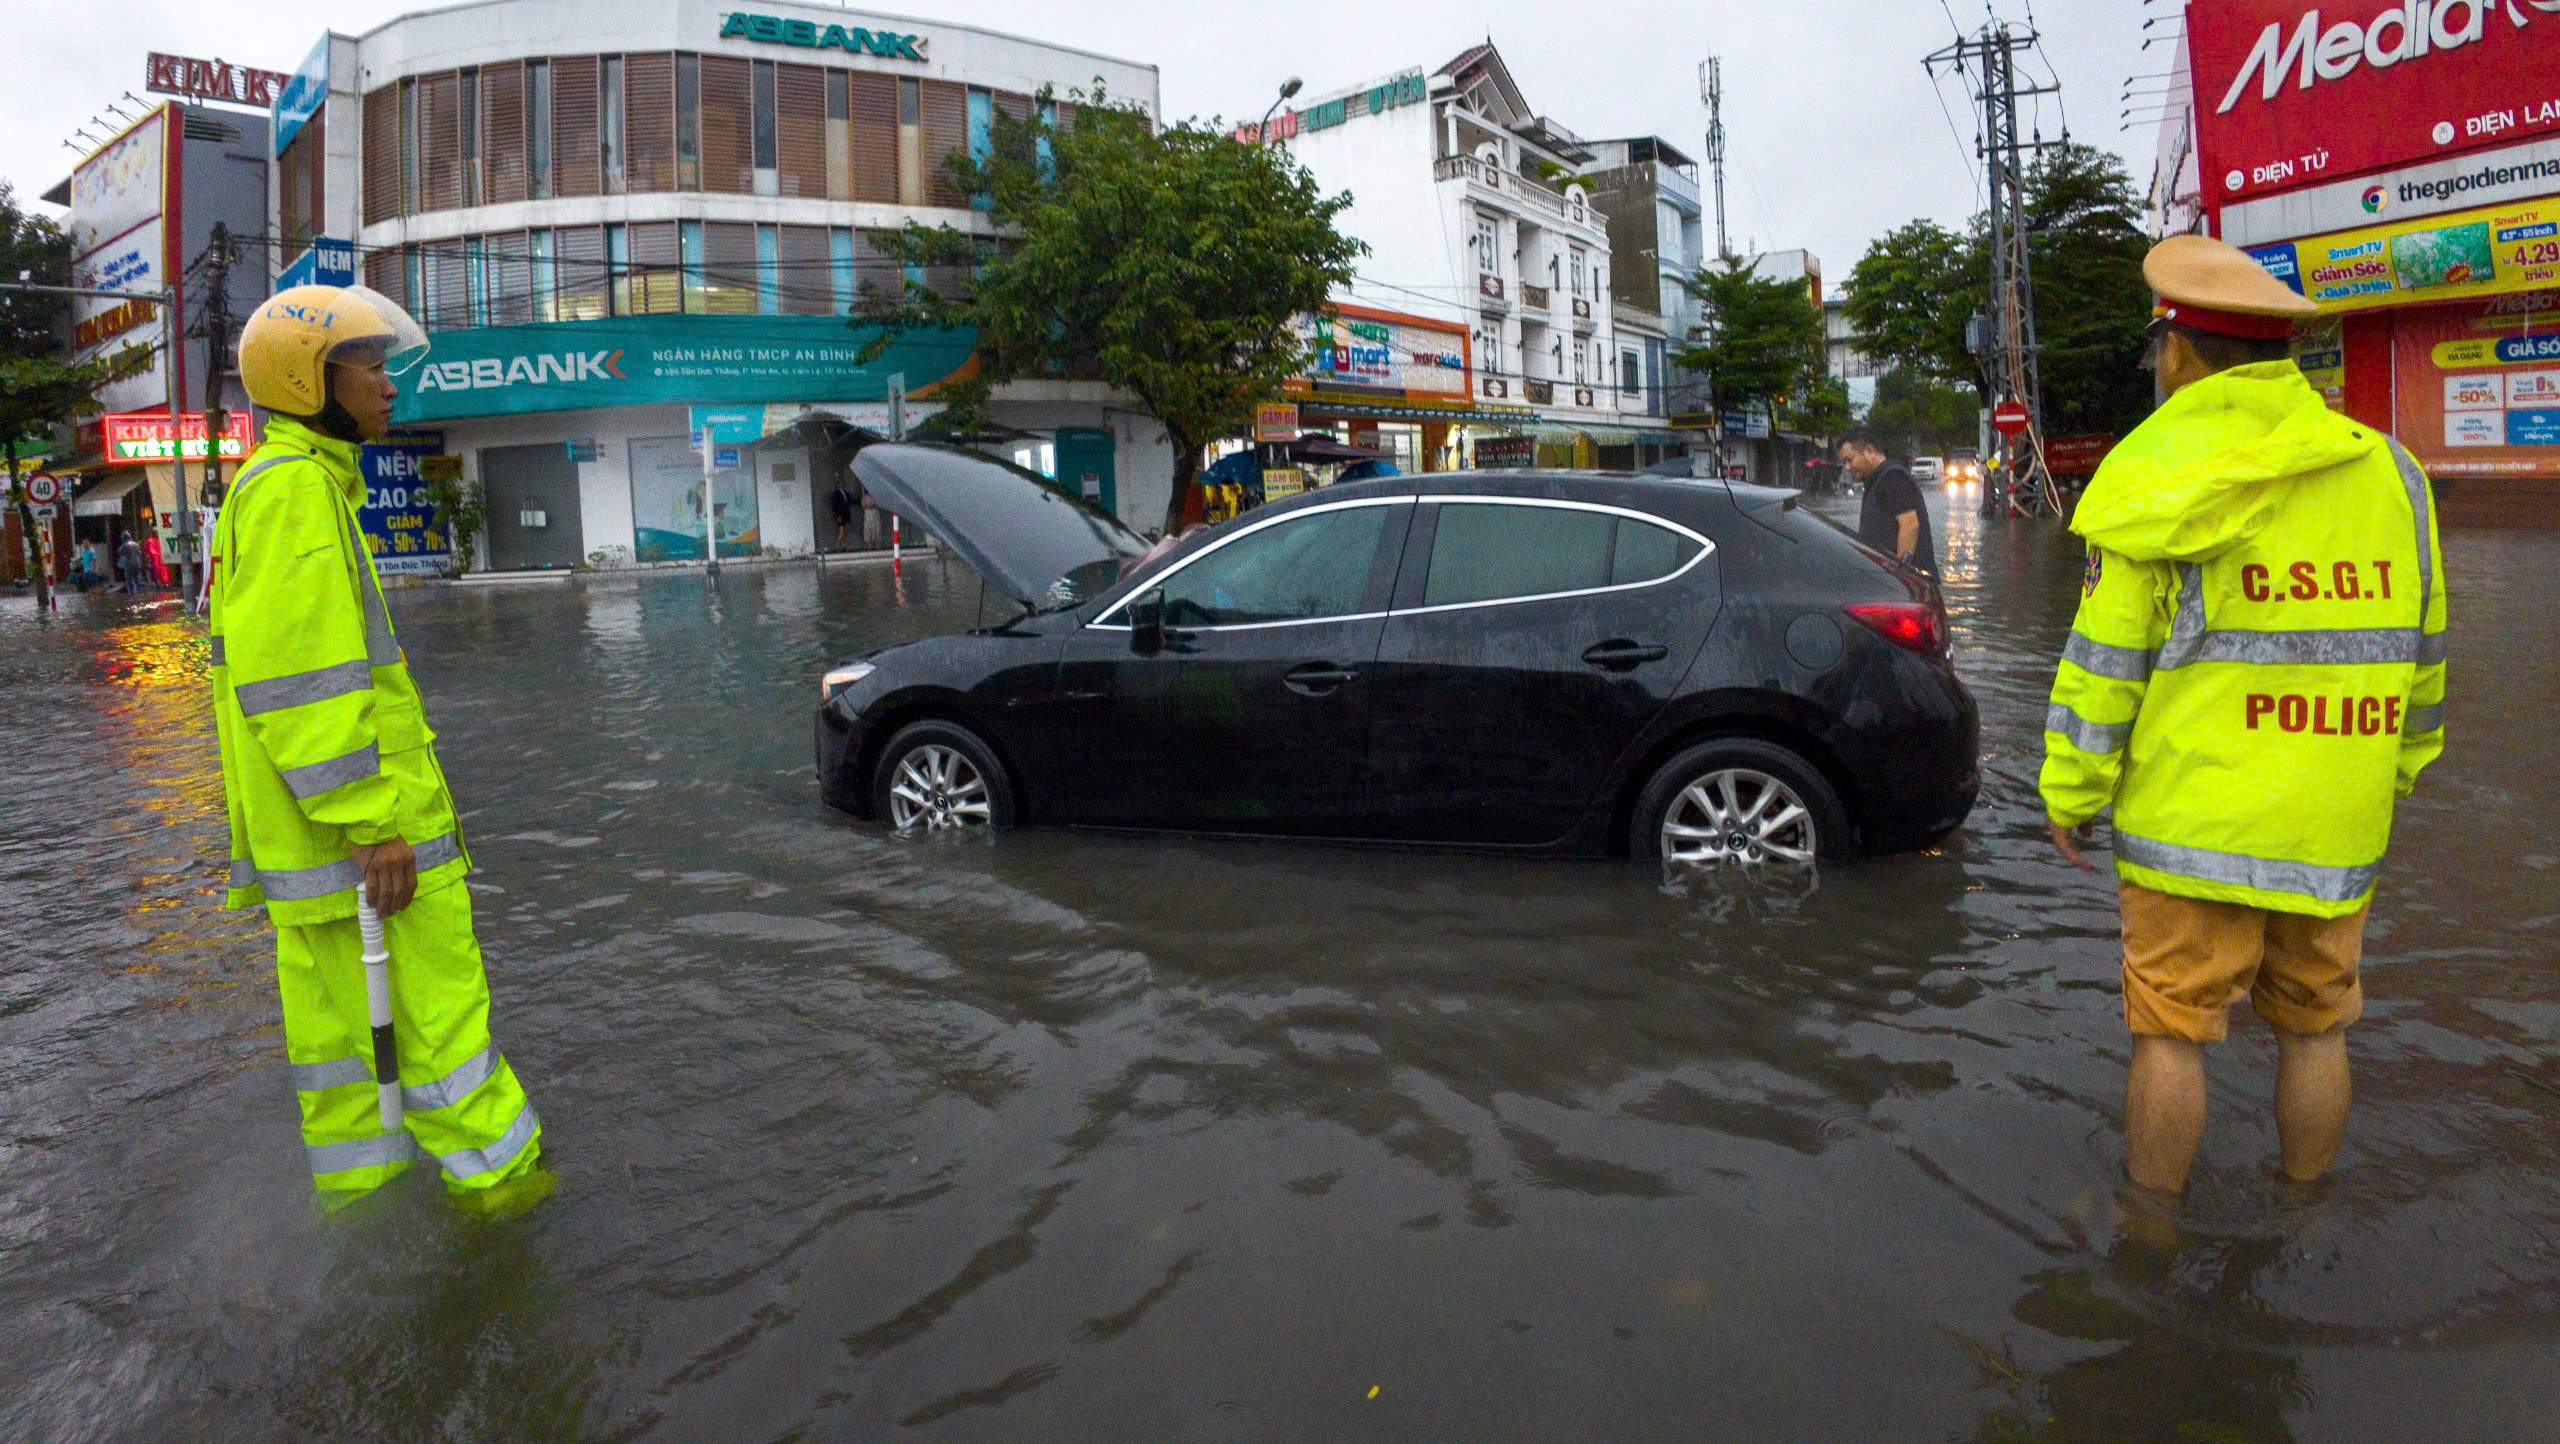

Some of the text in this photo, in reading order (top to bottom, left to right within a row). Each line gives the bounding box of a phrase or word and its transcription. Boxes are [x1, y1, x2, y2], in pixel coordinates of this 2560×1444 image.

[720, 12, 921, 62] ABBANK
[151, 53, 233, 100] KIM
[1306, 98, 1346, 133] KIM
[2466, 109, 2514, 136] ĐIỆN
[2252, 147, 2330, 184] ĐIỆN TỬ
[2524, 211, 2538, 222] TV
[318, 246, 352, 273] NỆM
[2328, 240, 2384, 260] Smart TV
[2311, 256, 2387, 283] Giảm Sốc
[2351, 282, 2360, 294] 3
[2360, 279, 2393, 293] triệu
[266, 303, 341, 329] CSGT
[652, 346, 855, 361] NGÂN HÀNG TMCP AN BÌNH
[2507, 339, 2536, 357] GIÁ
[416, 350, 611, 393] ABBANK
[116, 425, 158, 441] KIM
[35, 483, 50, 497] 40
[364, 487, 408, 509] CAO
[386, 511, 423, 529] GIẢM
[2241, 560, 2392, 602] C.S.G.T
[2246, 693, 2400, 736] POLICE
